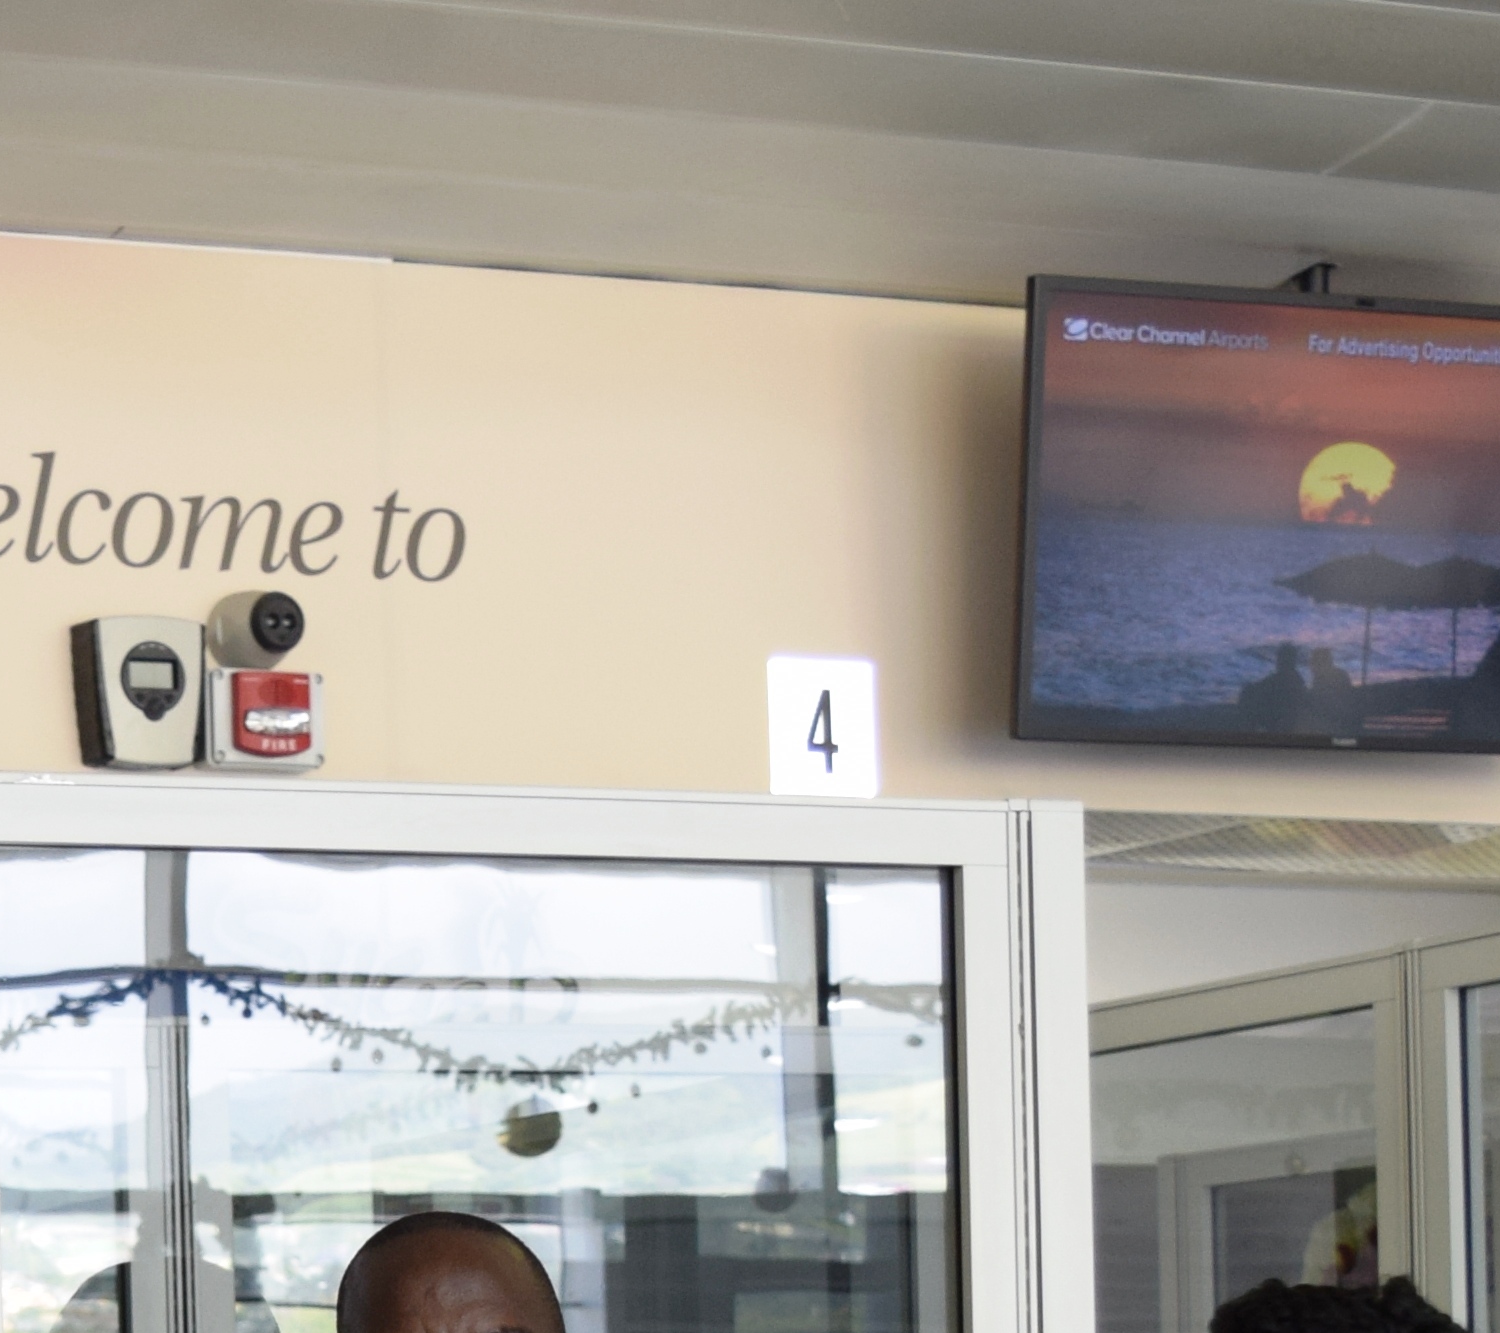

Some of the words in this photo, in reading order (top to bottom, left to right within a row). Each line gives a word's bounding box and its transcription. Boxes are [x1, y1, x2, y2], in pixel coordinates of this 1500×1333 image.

[1090, 322, 1134, 341] Clear
[1137, 325, 1205, 346] Channel
[1208, 330, 1268, 351] Airports
[1308, 335, 1333, 352] For
[1338, 337, 1418, 363] Advertising
[372, 489, 467, 583] to
[261, 738, 297, 751] FIRE
[805, 688, 840, 774] 4
